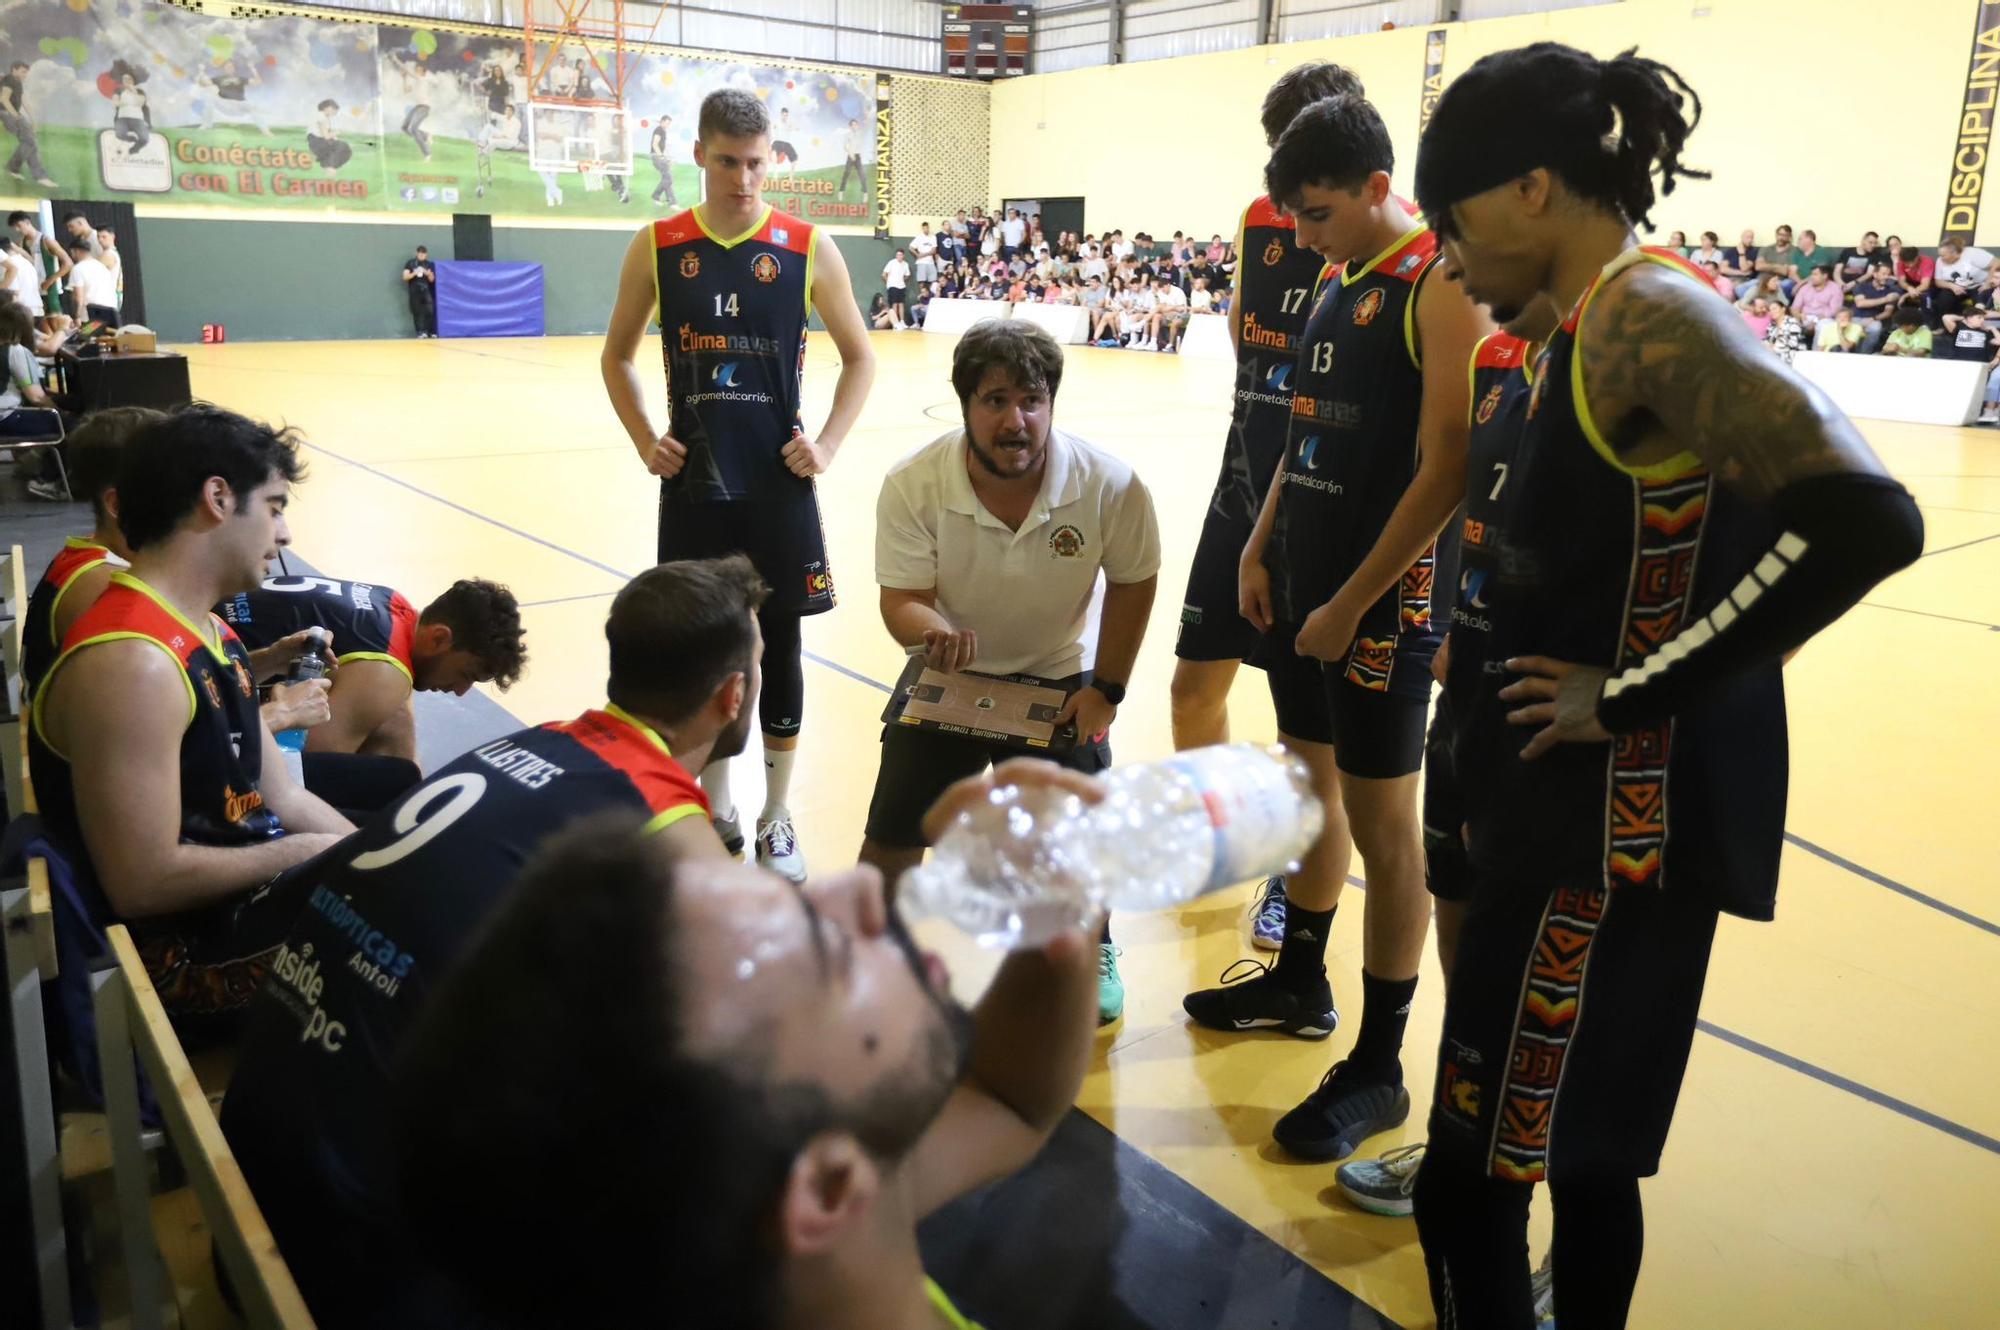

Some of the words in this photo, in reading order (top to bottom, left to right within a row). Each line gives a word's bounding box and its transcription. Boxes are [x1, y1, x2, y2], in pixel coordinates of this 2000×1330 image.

[1945, 25, 2000, 231] DISCIPLINA
[176, 139, 313, 170] Conéctate
[877, 107, 891, 230] CONFIANZA
[179, 171, 229, 193] con
[238, 170, 265, 193] El
[273, 174, 369, 199] Carmen
[761, 175, 834, 194] onéctate
[786, 198, 802, 216] El
[808, 198, 869, 218] Carmen
[714, 293, 740, 317] 14
[1280, 288, 1308, 314] 17
[680, 332, 779, 353] Climanavas
[1310, 341, 1334, 374] 13
[686, 391, 774, 406] agrometalcarrión
[1489, 463, 1508, 501] 7
[939, 721, 969, 735] TOWERS
[971, 727, 1008, 741] HAMBURG
[474, 739, 565, 790] LLASTRES
[350, 772, 487, 870] 9
[302, 1005, 346, 1051] pc
